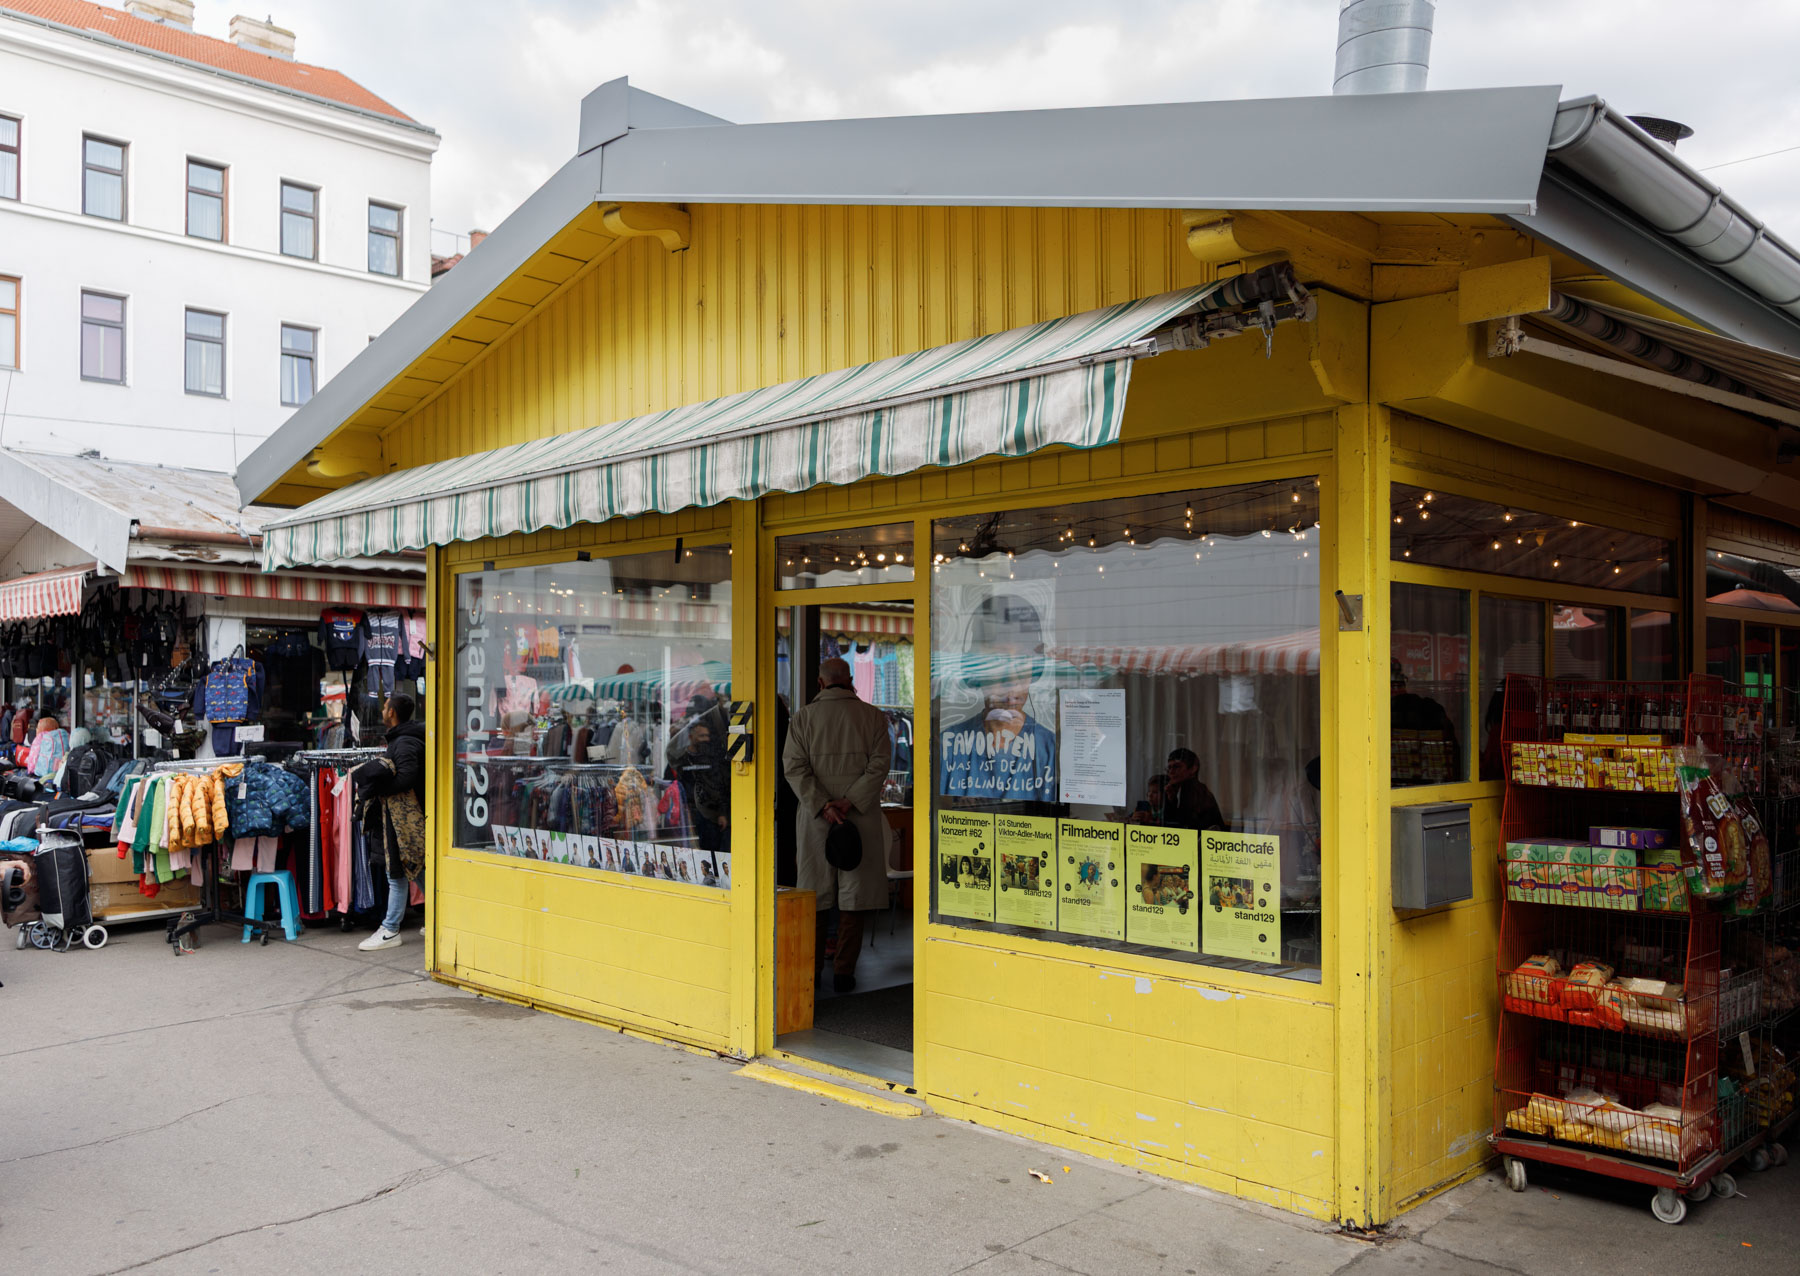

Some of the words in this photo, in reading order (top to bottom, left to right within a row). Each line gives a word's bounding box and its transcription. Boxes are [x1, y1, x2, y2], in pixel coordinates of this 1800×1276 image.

[466, 600, 490, 827] stand129
[942, 729, 1036, 761] FAVORITEN
[946, 758, 971, 772] WAS
[979, 758, 994, 772] IST
[1000, 758, 1032, 774] DEIN
[941, 814, 991, 827] Wohnzimmer-
[998, 819, 1005, 827] 24
[1006, 819, 1032, 829] Stunden
[941, 825, 968, 837] konzert
[969, 828, 983, 838] #62
[998, 828, 1052, 840] Viktor-Adler-Markt
[1061, 823, 1119, 841] Filmabend
[1130, 830, 1158, 844] Chor
[1160, 833, 1180, 846] 129
[1206, 837, 1274, 856] Sprachcafé
[1023, 889, 1052, 898] stand129
[1061, 896, 1091, 907] stand129
[1132, 904, 1164, 915] stand129
[1234, 911, 1275, 923] stand129
